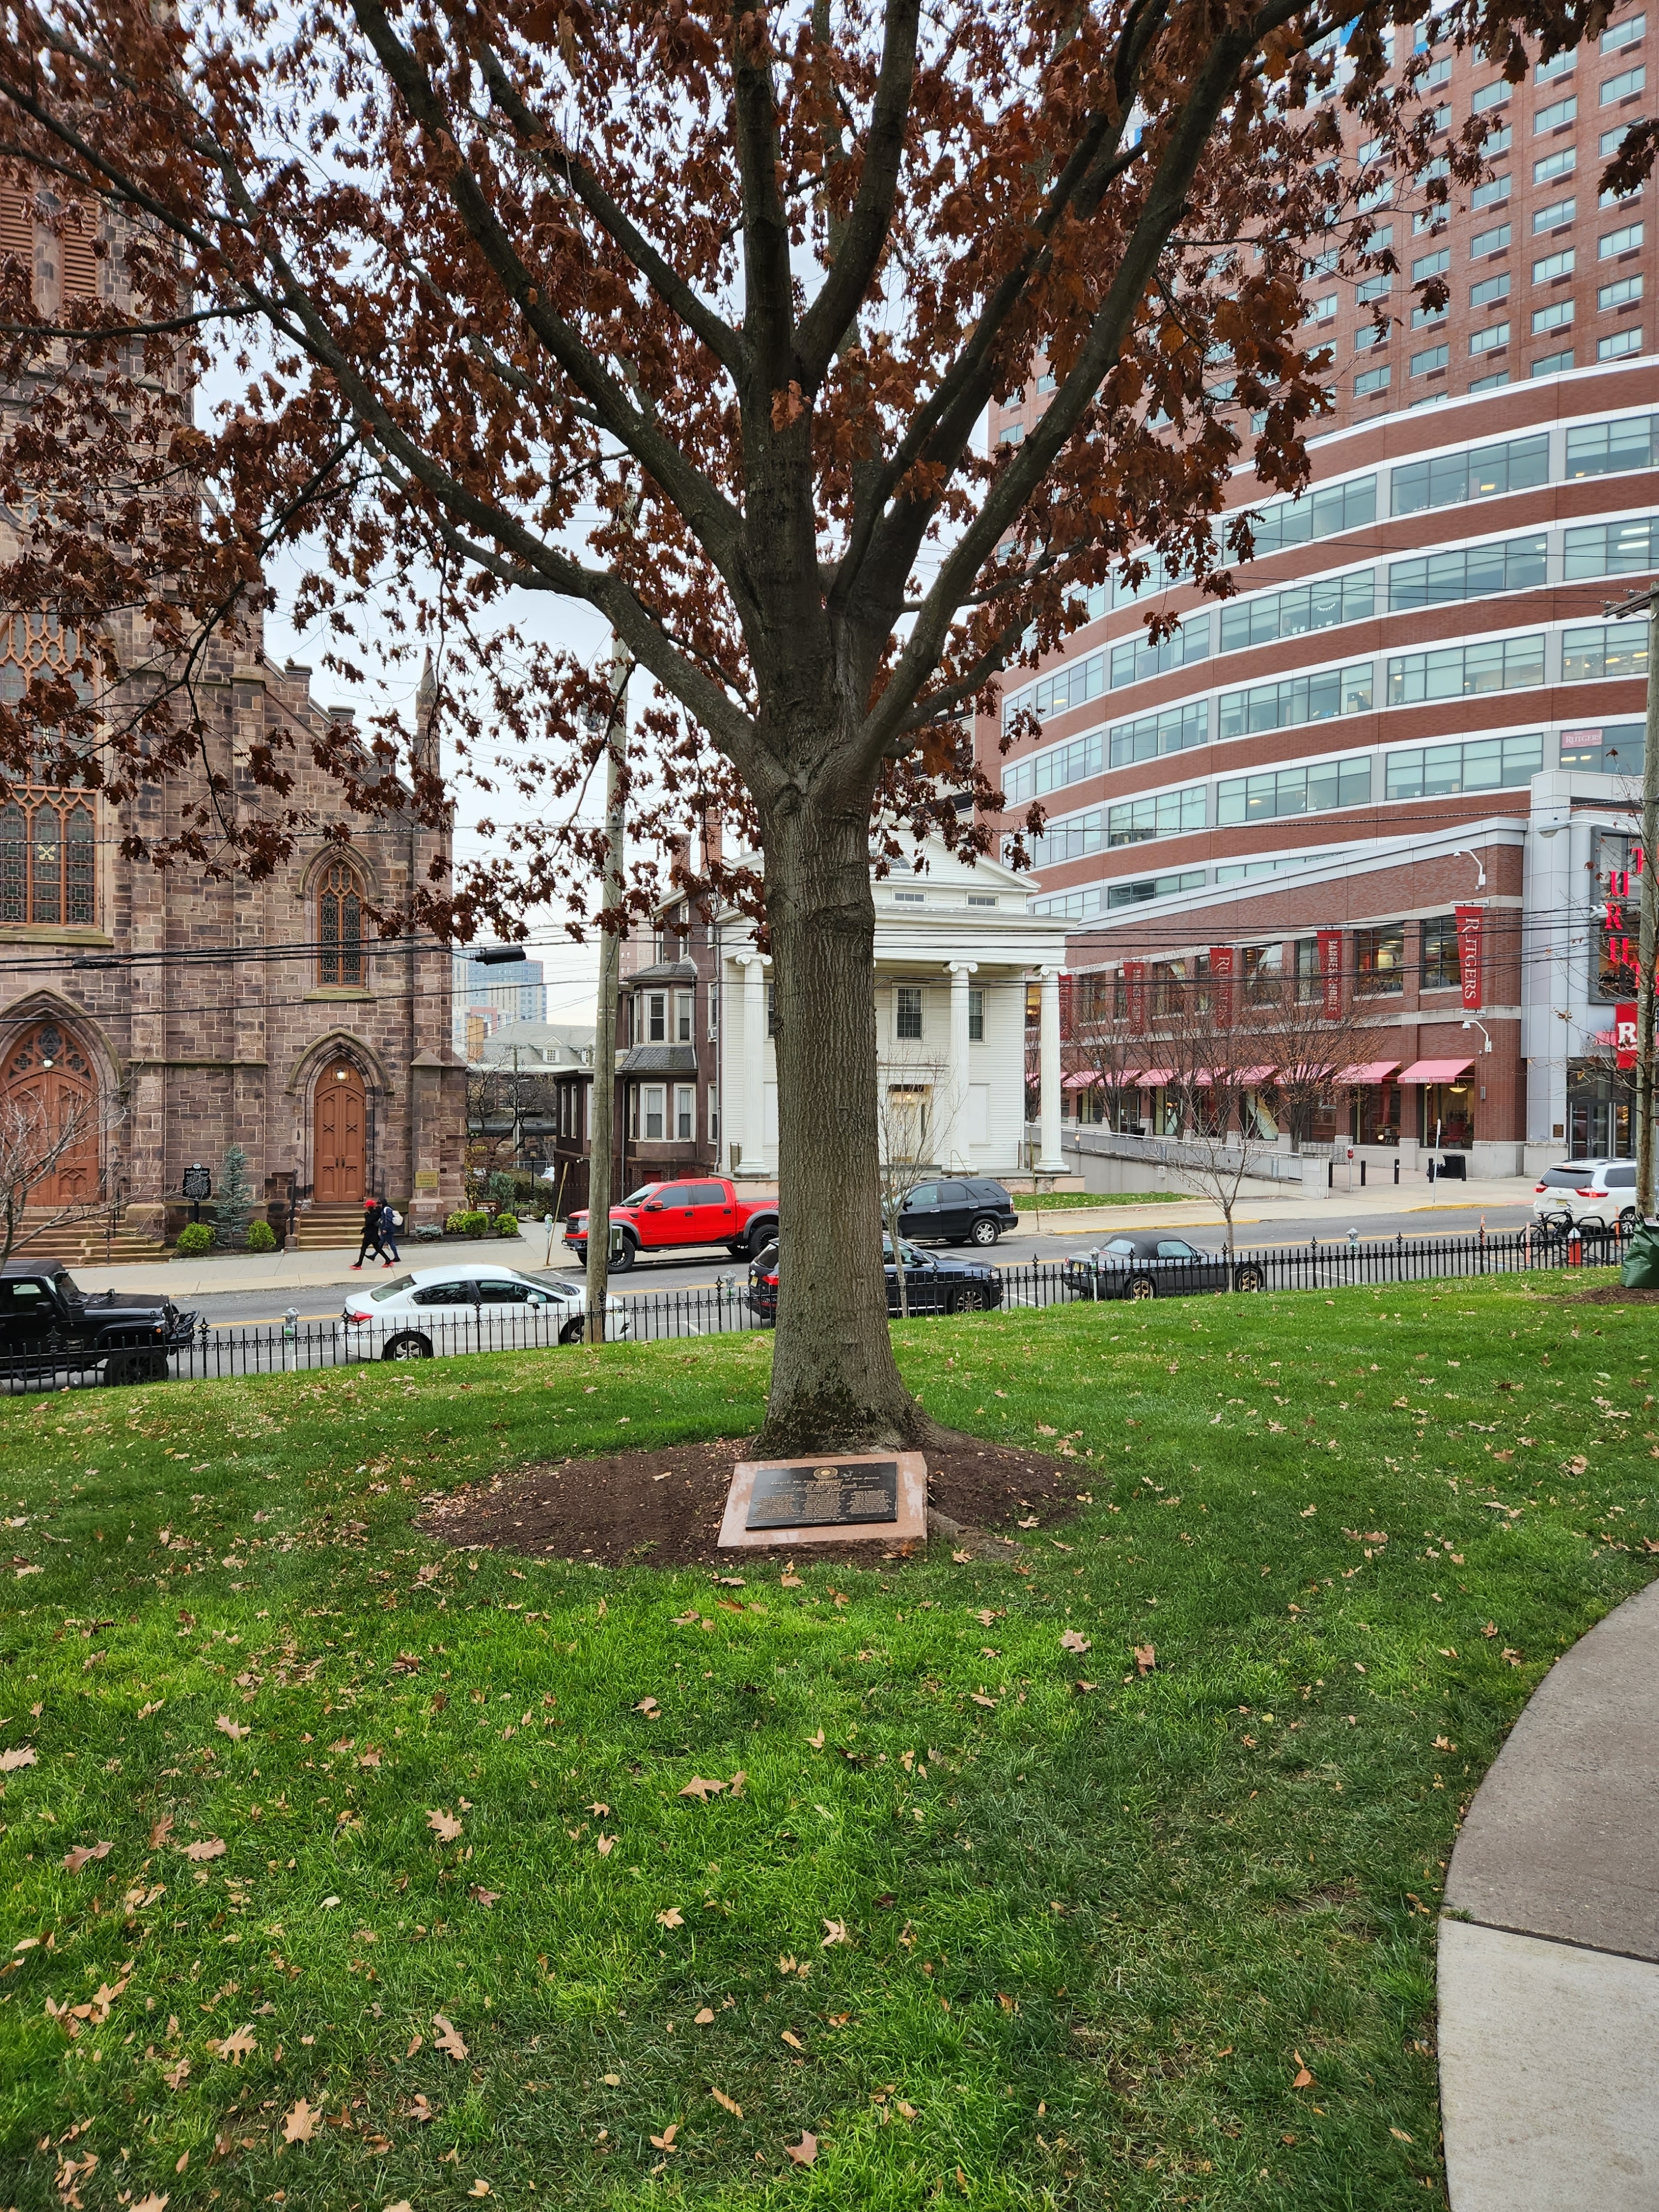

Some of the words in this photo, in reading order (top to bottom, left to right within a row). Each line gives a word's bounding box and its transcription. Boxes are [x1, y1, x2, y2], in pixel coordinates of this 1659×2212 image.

[1566, 734, 1601, 744] RUTGERS
[1461, 918, 1479, 999] RUTGERS
[1618, 1022, 1637, 1044] R
